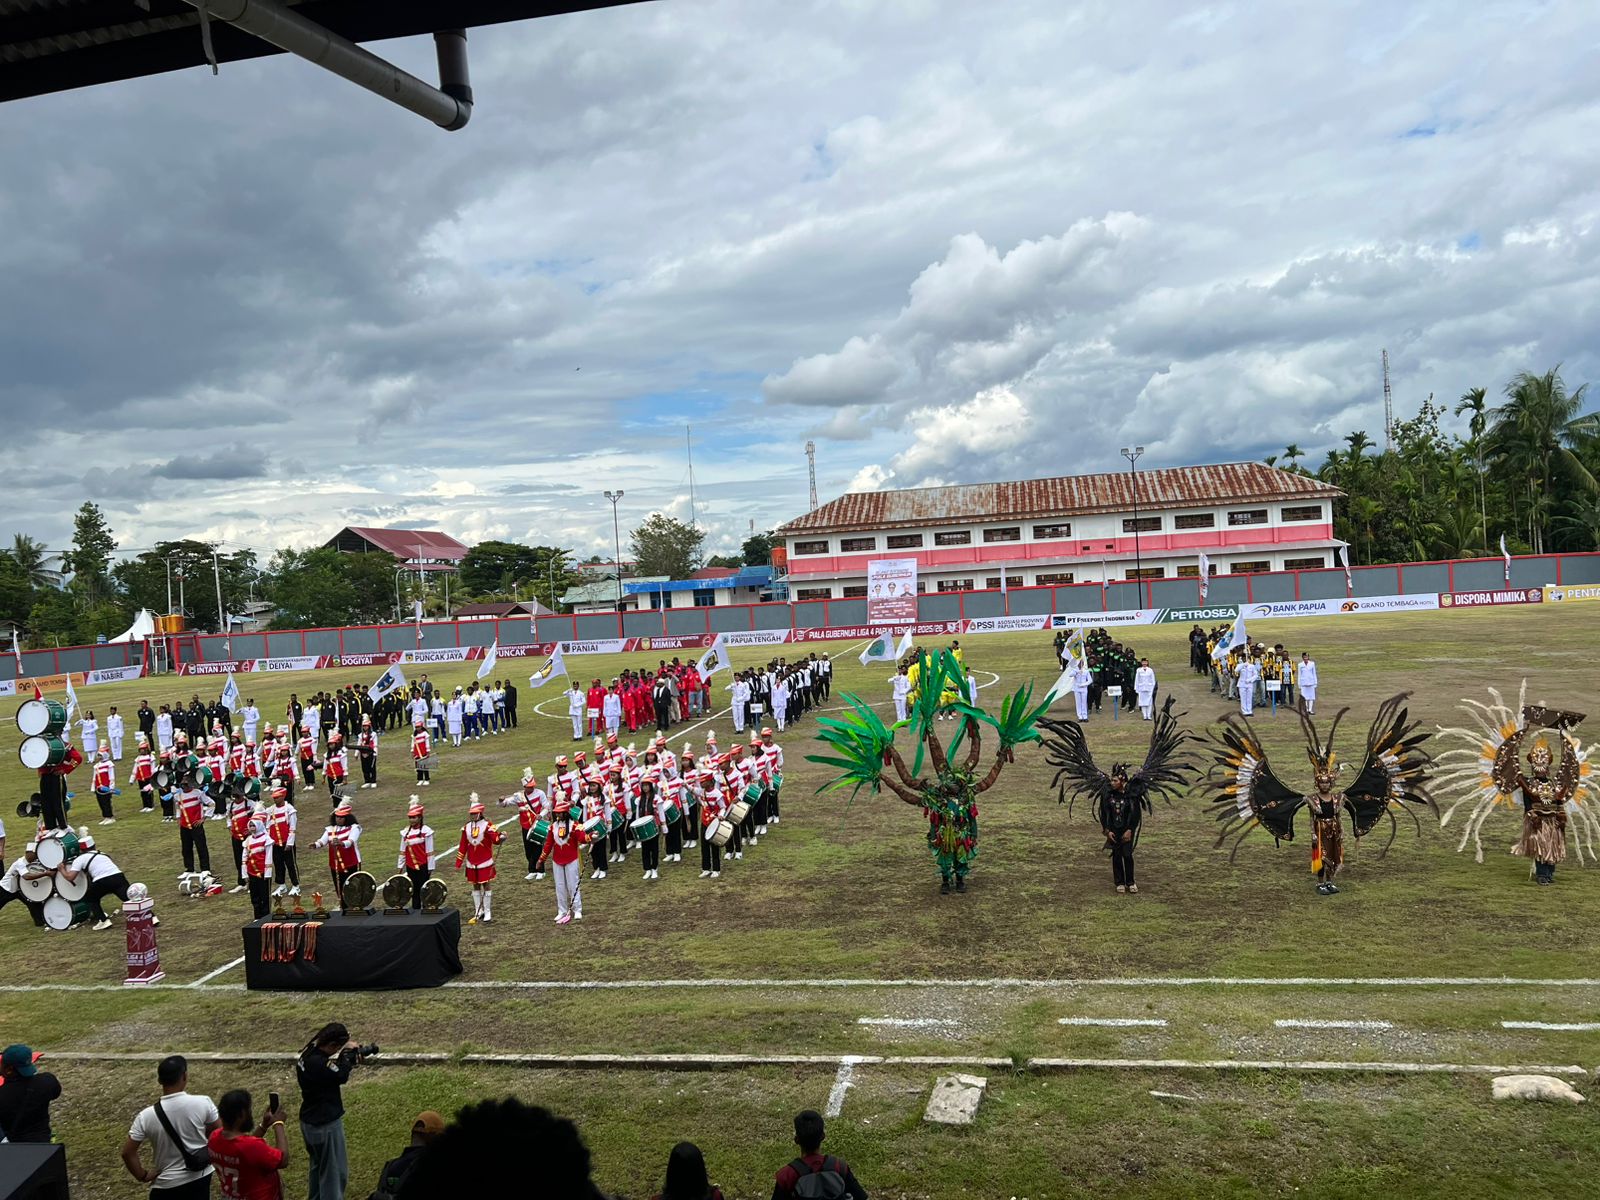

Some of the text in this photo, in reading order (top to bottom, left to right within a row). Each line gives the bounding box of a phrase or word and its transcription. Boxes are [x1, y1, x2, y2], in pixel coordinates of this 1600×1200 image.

[1455, 591, 1526, 605] DISPORA MIMIKA
[1298, 602, 1326, 610] PAPUA
[1170, 608, 1236, 620] PETROSEA
[976, 621, 994, 630] PSSI
[826, 630, 856, 638] GUBERNUR
[857, 628, 870, 636] LIGA
[918, 624, 944, 632] 2025/26
[754, 636, 781, 644] TENGAH
[652, 640, 682, 650] MIMIKA
[572, 646, 598, 654] PANIAI
[446, 652, 464, 660] JAYA
[342, 657, 372, 666] DOGIYAI
[196, 664, 236, 674] INTAN JAYA
[102, 672, 124, 680] NABIRE
